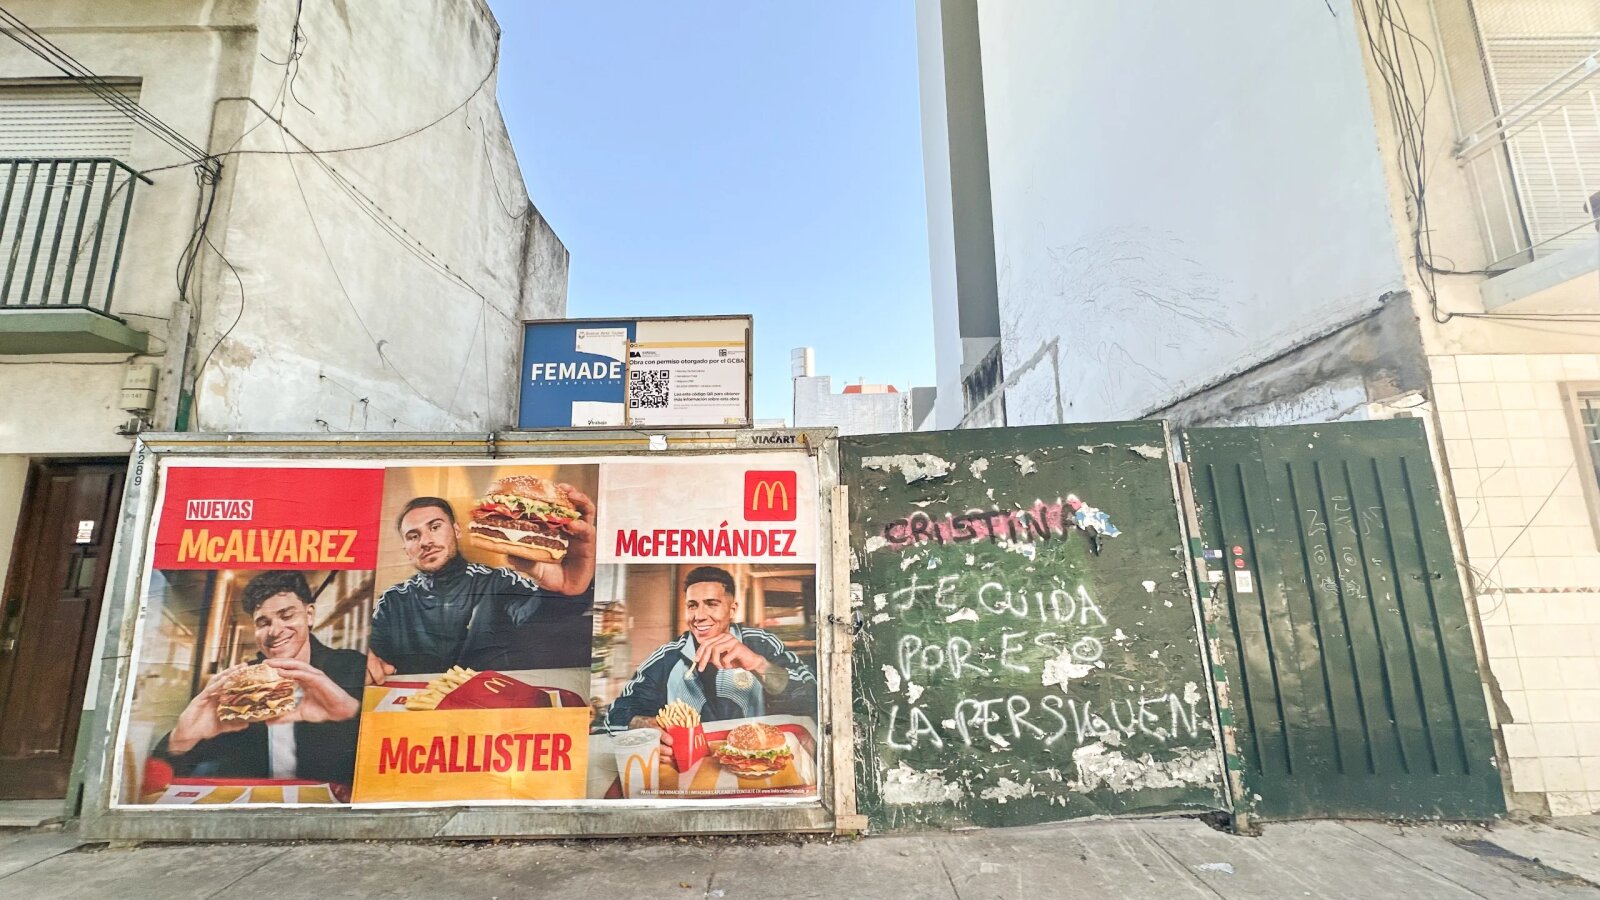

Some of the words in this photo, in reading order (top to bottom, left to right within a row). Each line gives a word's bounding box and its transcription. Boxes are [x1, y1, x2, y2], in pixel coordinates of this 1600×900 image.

[531, 361, 621, 380] FEMADE
[751, 435, 796, 444] VIACART
[134, 444, 146, 486] 2289
[188, 501, 251, 519] NUEVAS
[177, 529, 358, 563] McALVAREZ
[615, 520, 797, 557] McFERNÁNDEZ
[899, 634, 992, 681] POR
[1001, 631, 1103, 673] ESO
[886, 704, 943, 750] LA
[954, 693, 1198, 746] PERSIGUEN
[378, 733, 573, 774] McALLISTER
